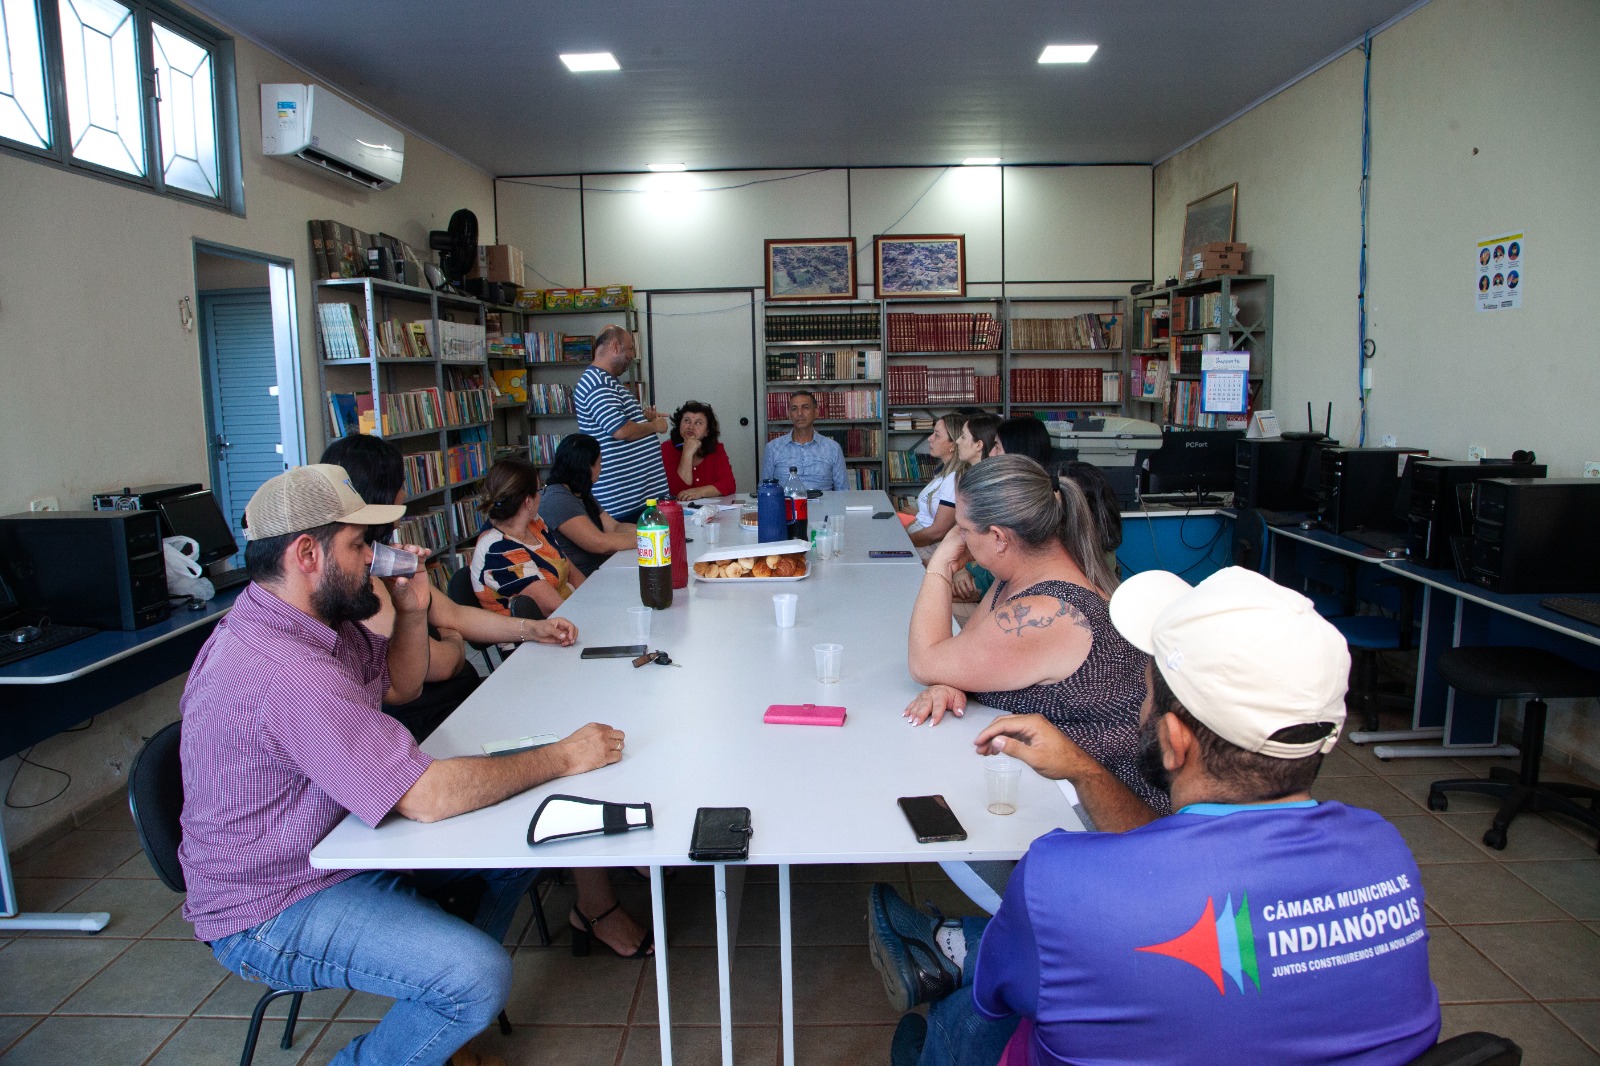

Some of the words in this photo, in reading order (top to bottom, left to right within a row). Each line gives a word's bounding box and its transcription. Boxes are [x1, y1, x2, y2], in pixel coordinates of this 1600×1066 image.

[1263, 895, 1336, 922] CÂMARA
[1336, 879, 1401, 909] MUNICIPAL
[1396, 873, 1411, 891] DE
[1267, 896, 1421, 957] INDIANÓPOLIS
[1272, 961, 1308, 978] JUNTOS
[1308, 947, 1375, 971] CONSTRUIREMOS
[1373, 942, 1390, 956] UMA
[1389, 937, 1407, 951] NOVA
